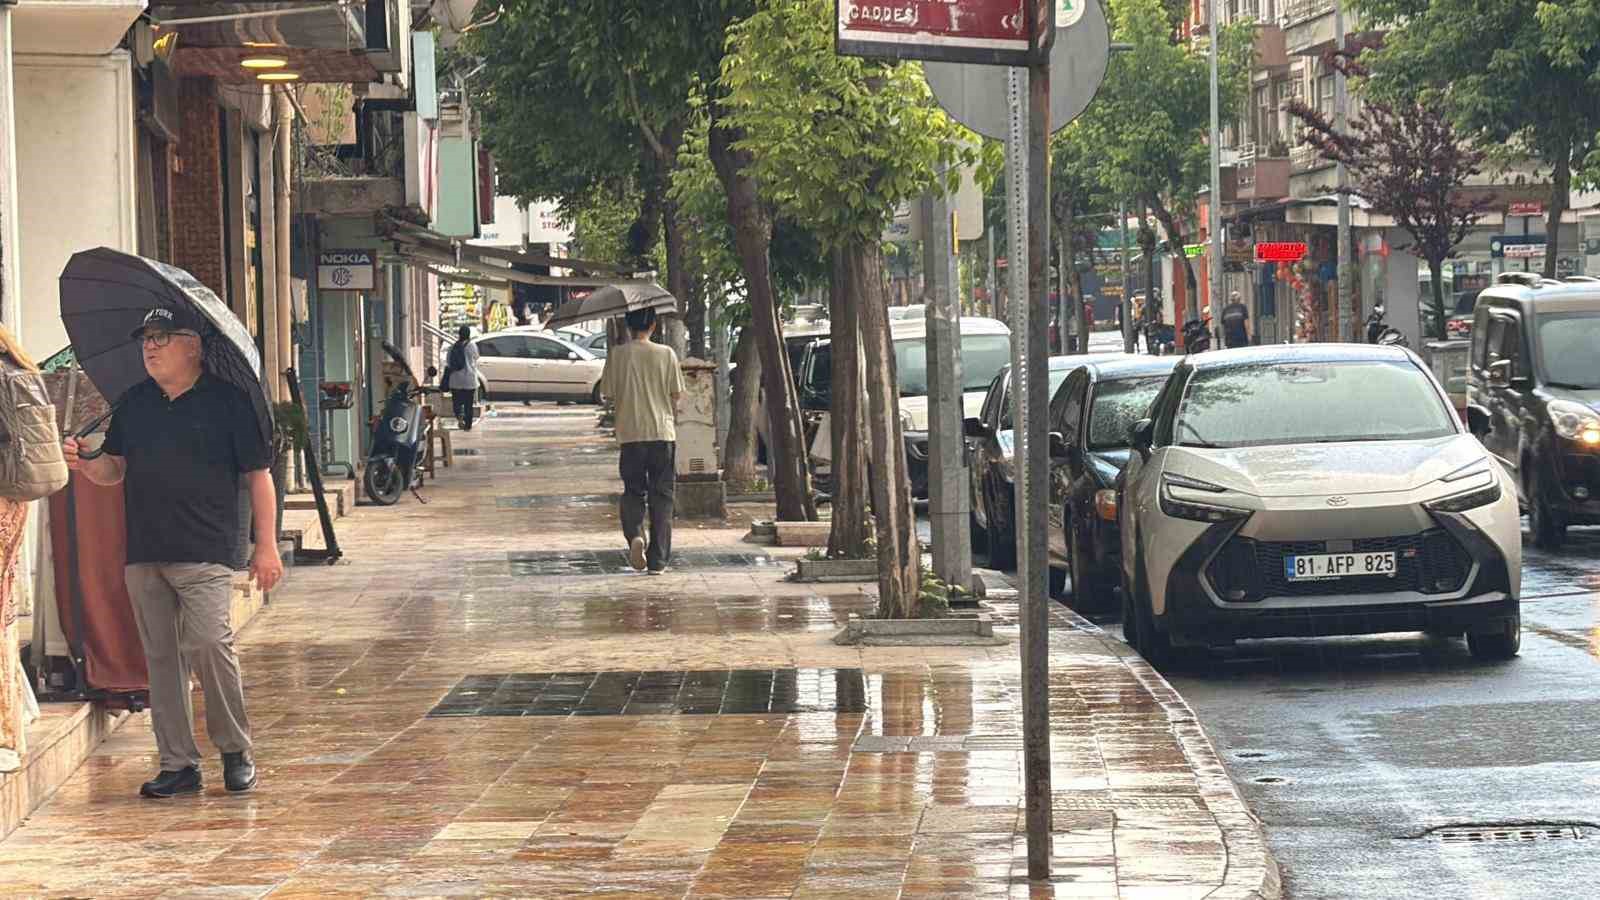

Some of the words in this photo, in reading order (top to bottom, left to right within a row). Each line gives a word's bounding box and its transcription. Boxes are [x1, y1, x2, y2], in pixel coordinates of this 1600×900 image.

[320, 254, 371, 264] NOKIA
[1296, 558, 1315, 576] 81
[1327, 556, 1355, 574] AFP
[1364, 554, 1395, 572] 825
